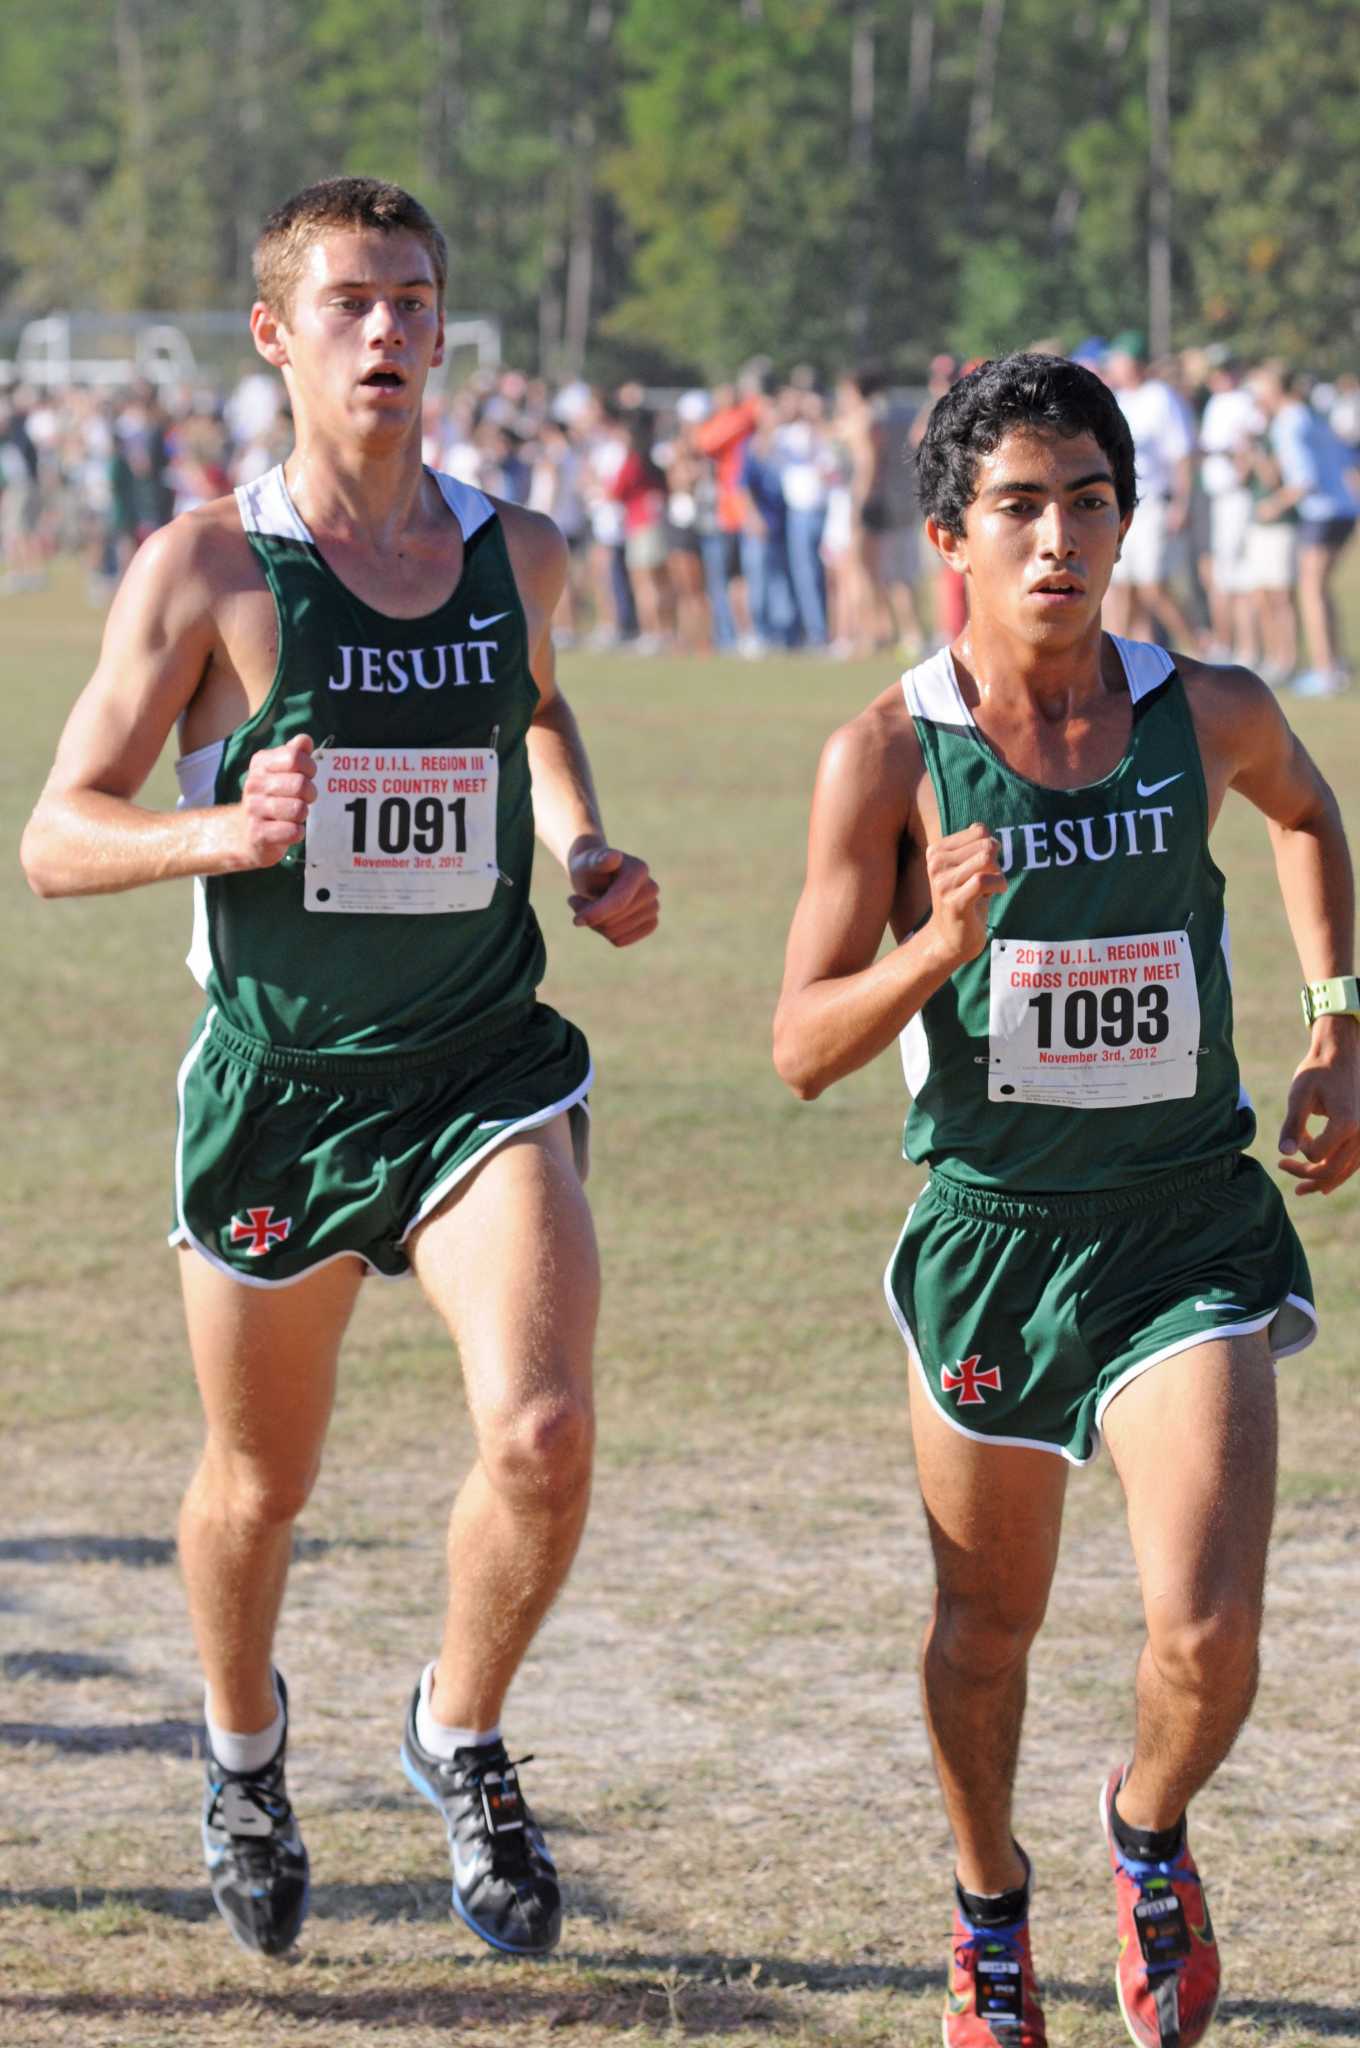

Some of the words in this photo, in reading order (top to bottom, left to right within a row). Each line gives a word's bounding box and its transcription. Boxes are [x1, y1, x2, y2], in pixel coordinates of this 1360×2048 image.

[329, 641, 498, 693] JESUIT
[333, 757, 369, 771] 2012
[375, 757, 415, 771] U.I.L.
[422, 756, 467, 771] REGION
[471, 756, 484, 770] III
[328, 779, 376, 793] CROSS
[383, 779, 448, 794] COUNTRY
[454, 779, 487, 793] MEET
[345, 797, 467, 854] 1091
[995, 806, 1173, 872] JESUIT
[353, 856, 410, 868] November
[414, 856, 435, 869] 3rd,
[439, 855, 463, 868] 2012
[1016, 949, 1054, 965] 2012
[1061, 947, 1101, 964] U.I.L.
[1108, 942, 1159, 960] REGION
[1164, 939, 1176, 955] III
[1011, 972, 1062, 988] CROSS
[1068, 967, 1136, 987] COUNTRY
[1144, 963, 1181, 981] MEET
[1029, 985, 1169, 1049] 1093
[1040, 1050, 1097, 1064] November
[1102, 1049, 1125, 1063] 3rd,
[1130, 1047, 1157, 1061] 2012
